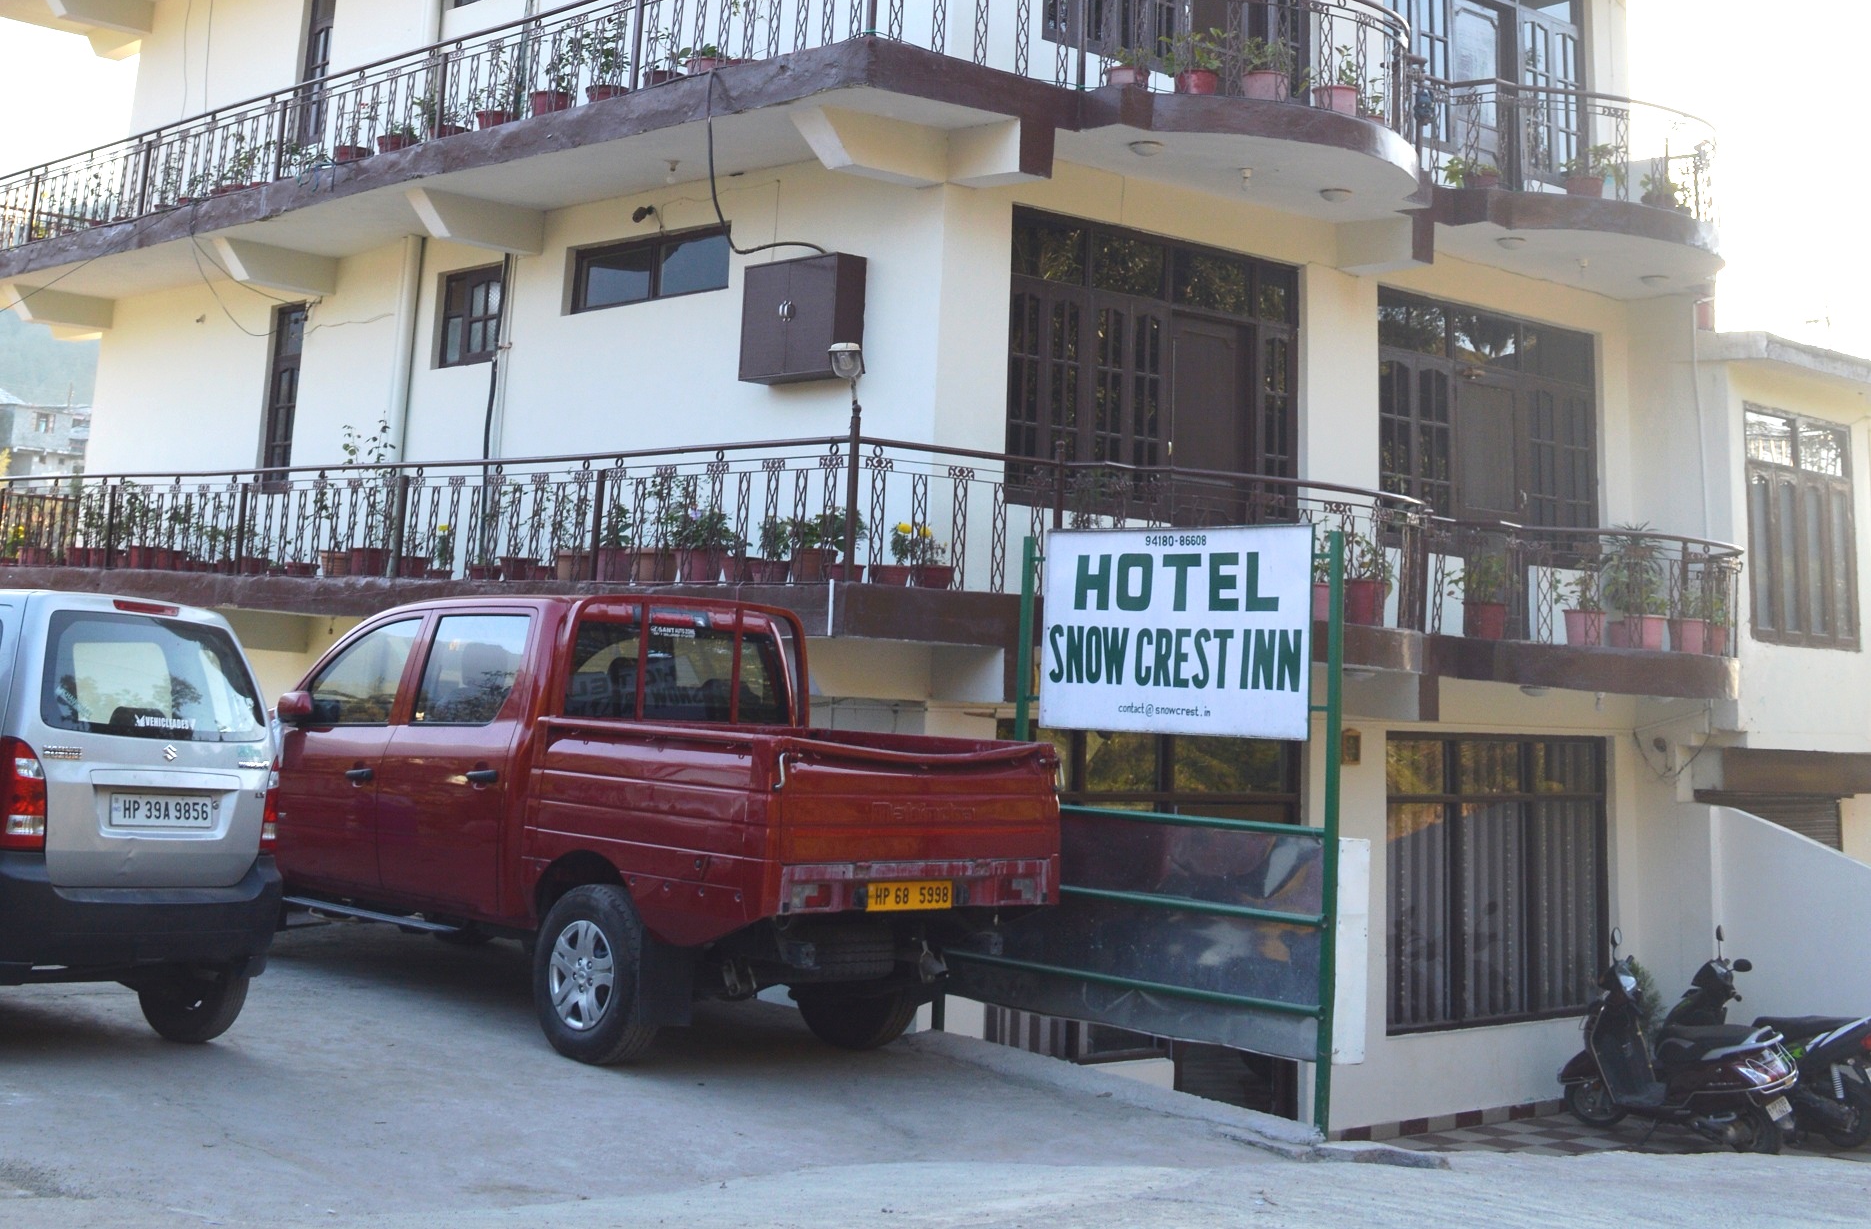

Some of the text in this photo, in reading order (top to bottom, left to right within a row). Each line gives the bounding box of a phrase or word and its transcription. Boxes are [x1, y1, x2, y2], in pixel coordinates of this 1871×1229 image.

[1145, 535, 1207, 547] 94180-86608
[1074, 551, 1279, 612] HOTEL
[1049, 624, 1302, 692] SNOW CREST INN
[123, 799, 209, 820] HP 39A 9856
[875, 886, 949, 905] HP 68 5998
